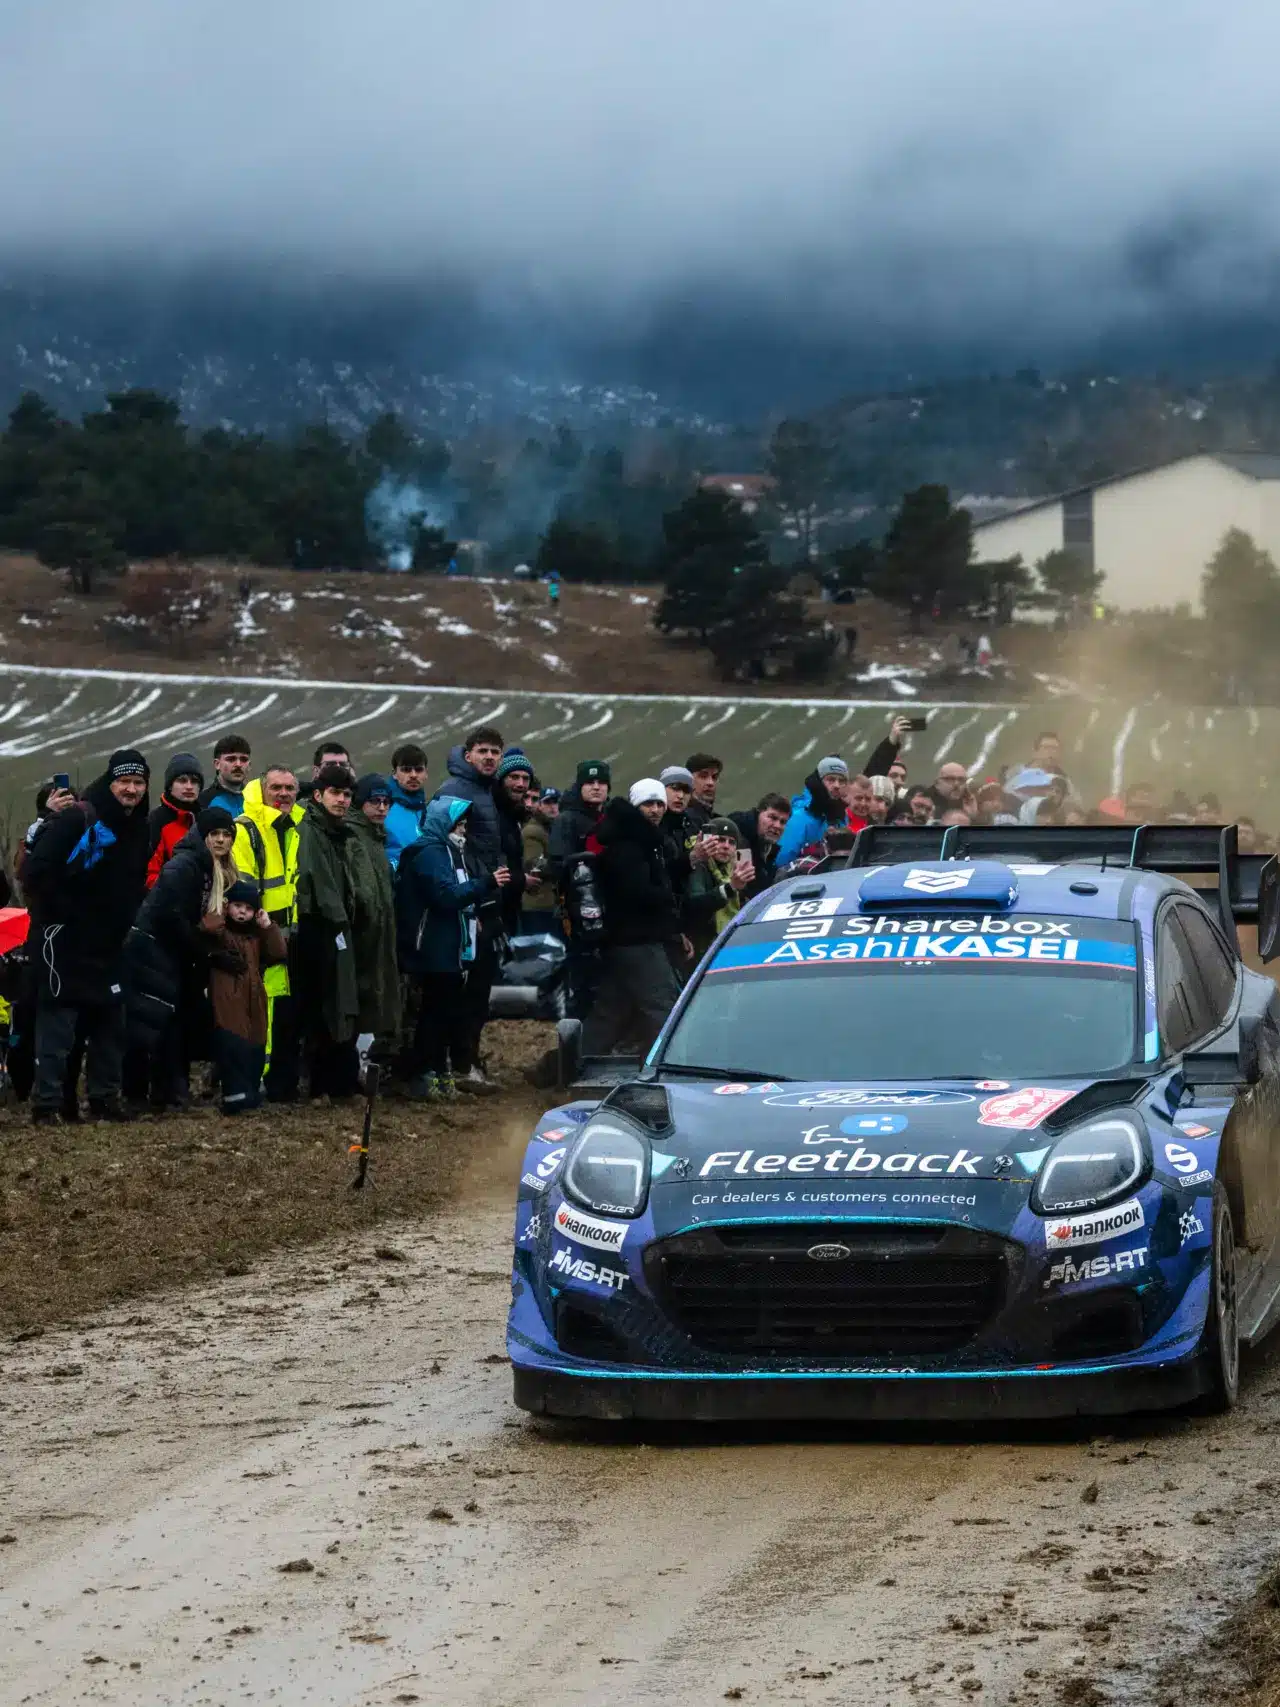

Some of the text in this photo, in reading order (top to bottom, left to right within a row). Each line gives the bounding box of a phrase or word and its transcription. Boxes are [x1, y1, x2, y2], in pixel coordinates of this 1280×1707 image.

[786, 900, 823, 917] 13
[842, 916, 1073, 937] Sharebox
[799, 1090, 941, 1105] Ford
[699, 1147, 984, 1177] Fleetback
[1180, 1170, 1212, 1187] sparco
[692, 1191, 976, 1206] Car dealers & customers connected
[817, 1247, 841, 1258] Ford
